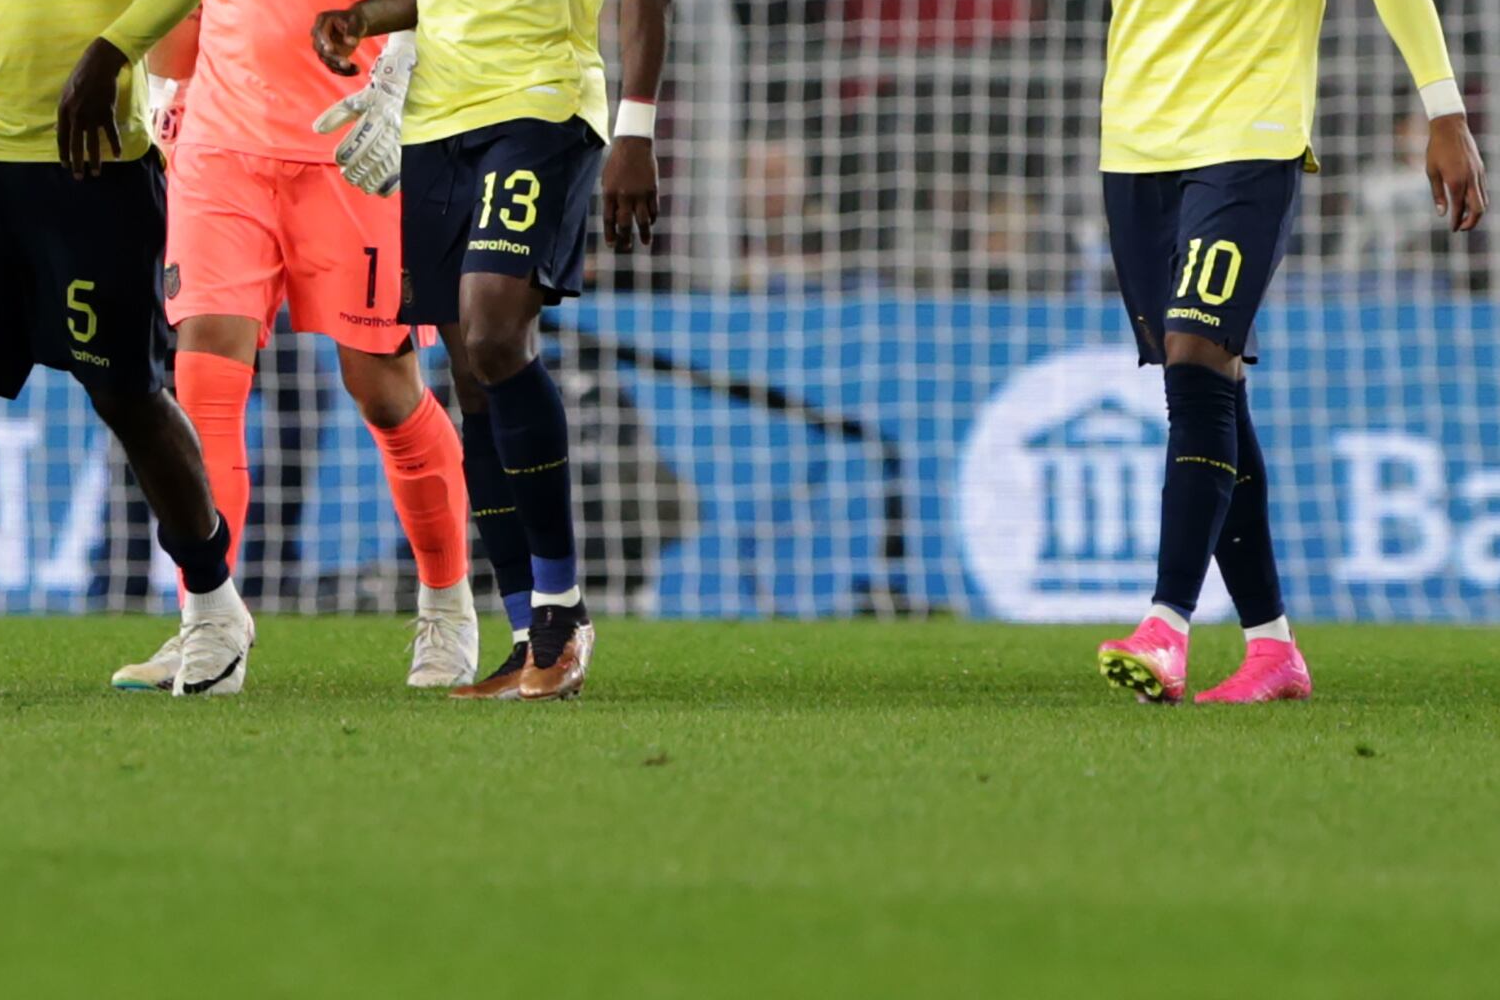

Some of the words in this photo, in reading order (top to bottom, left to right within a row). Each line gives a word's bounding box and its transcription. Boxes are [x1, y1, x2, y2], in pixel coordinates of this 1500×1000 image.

[478, 169, 541, 232] 13
[363, 246, 378, 309] 1
[467, 239, 530, 256] marathon
[1176, 238, 1242, 306] 10
[67, 280, 97, 343] 5
[70, 348, 110, 368] athon
